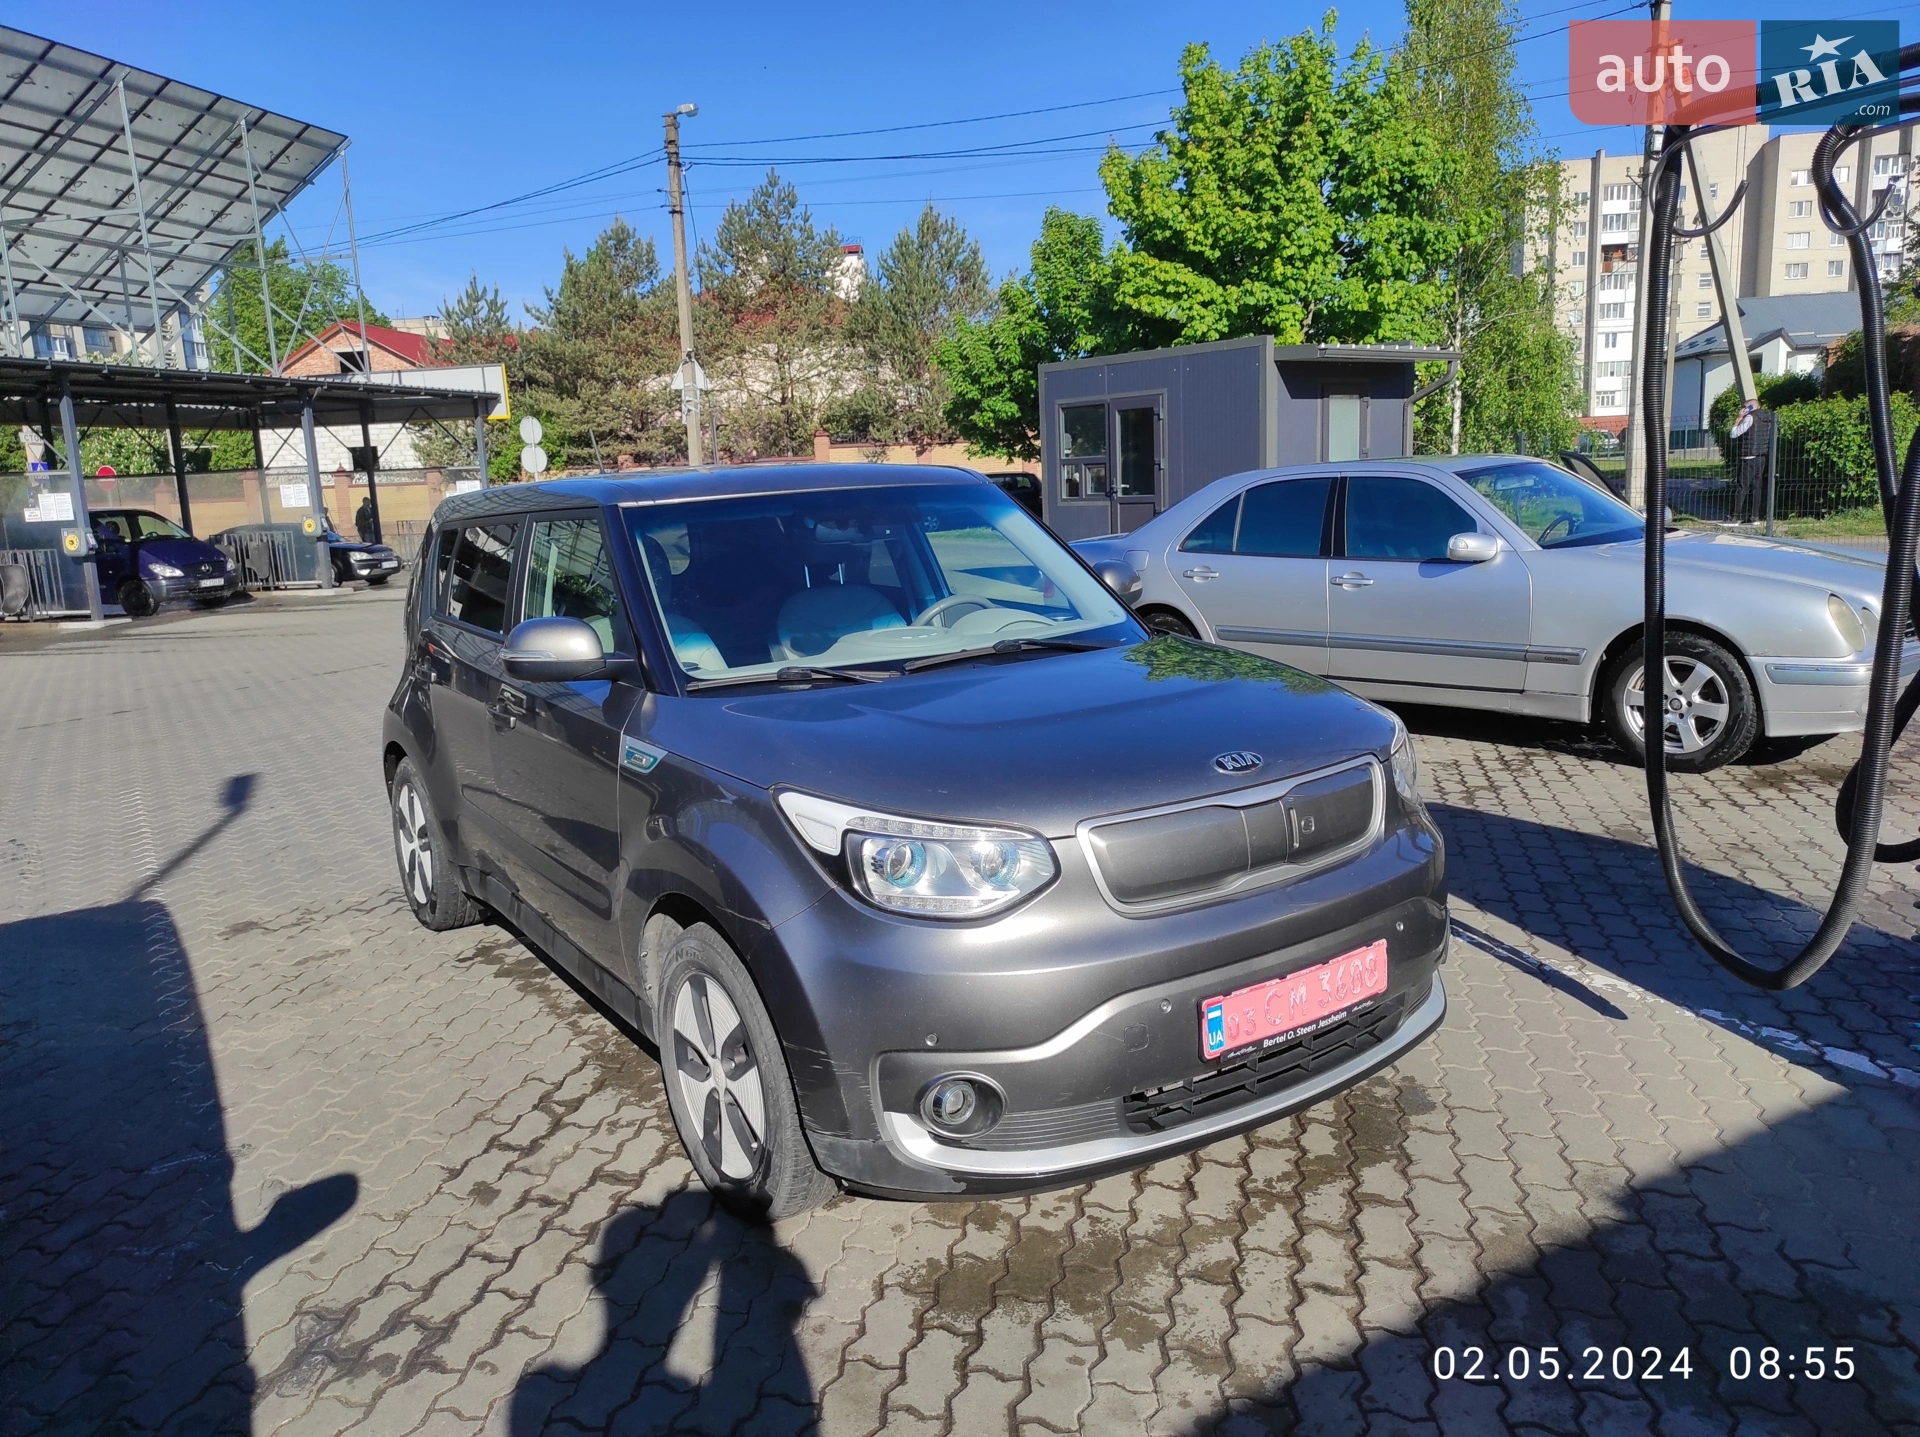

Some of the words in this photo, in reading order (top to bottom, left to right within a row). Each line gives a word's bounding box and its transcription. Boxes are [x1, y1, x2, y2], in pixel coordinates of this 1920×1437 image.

[1218, 753, 1260, 770] KIA
[1227, 1006, 1257, 1041] 03
[1263, 1032, 1287, 1048] Bertel
[1287, 1030, 1296, 1040] O.
[1296, 1023, 1317, 1037] Steen
[1317, 1011, 1347, 1029] Jessheim
[1208, 1029, 1224, 1046] UA
